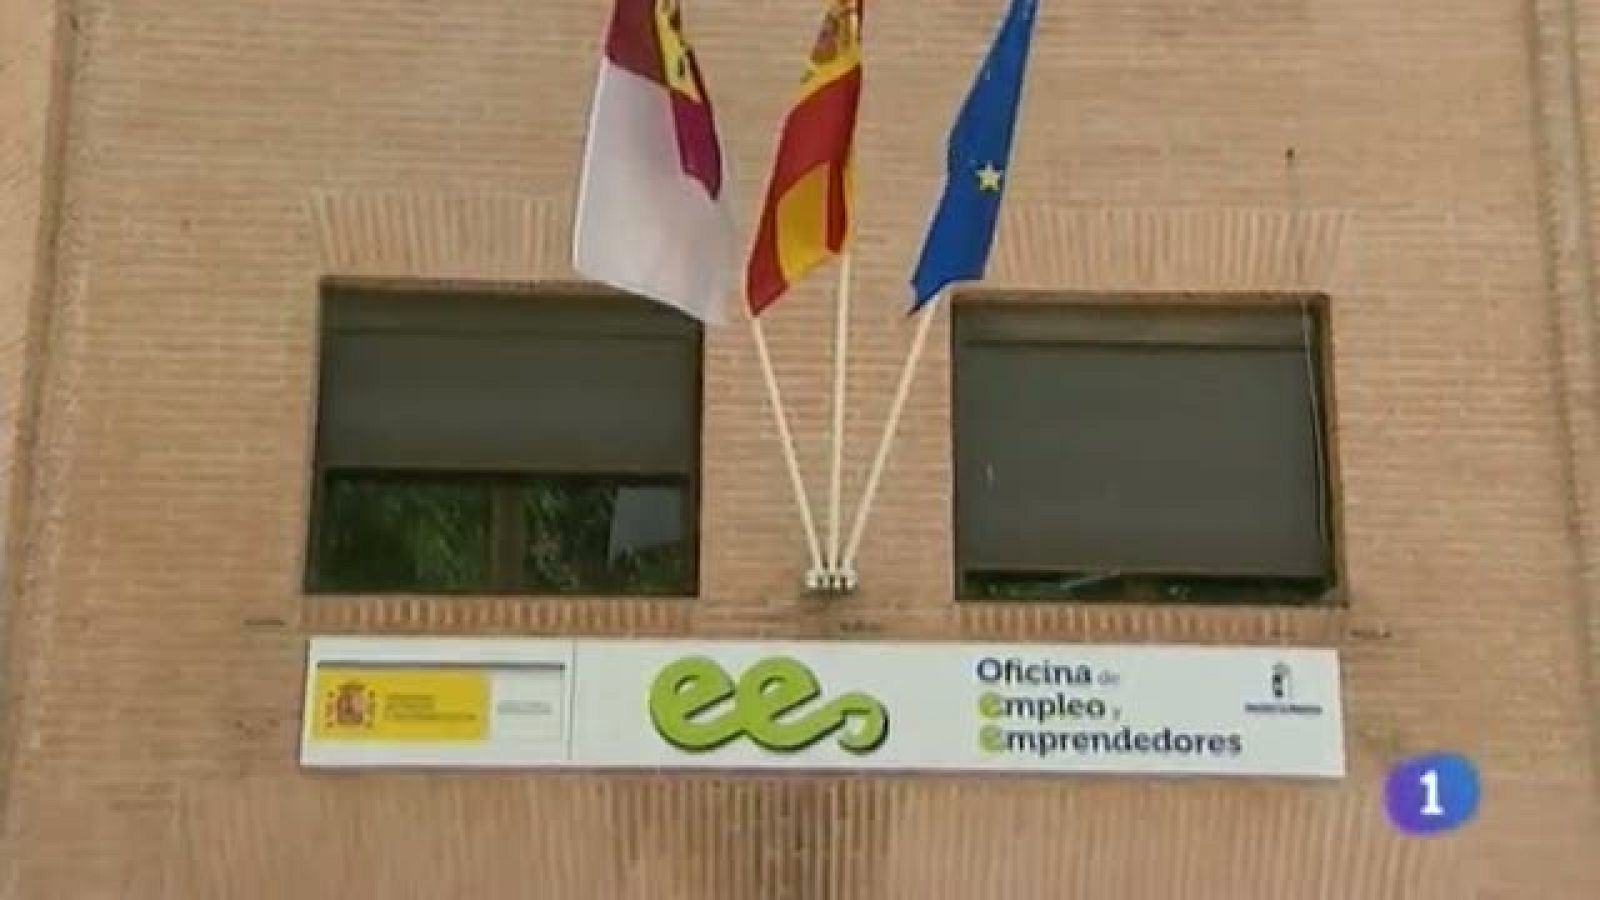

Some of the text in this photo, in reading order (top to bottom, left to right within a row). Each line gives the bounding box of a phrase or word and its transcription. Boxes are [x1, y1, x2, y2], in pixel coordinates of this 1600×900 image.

[976, 658, 1093, 686] Oficina
[978, 692, 1107, 723] empleo
[978, 725, 1243, 758] emprendedores
